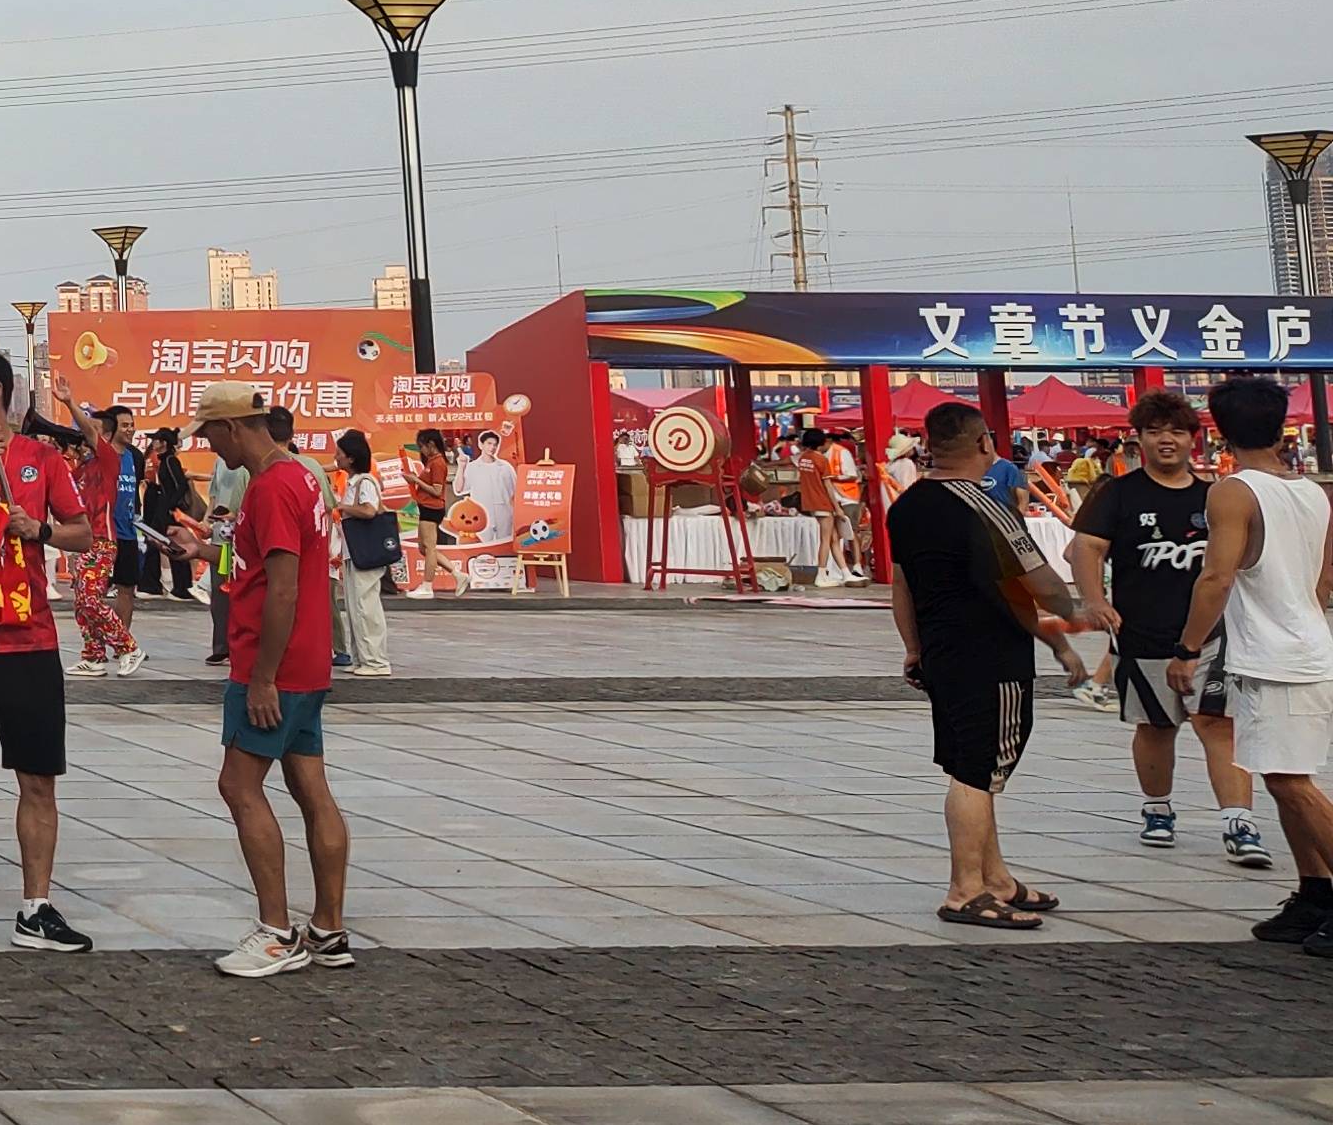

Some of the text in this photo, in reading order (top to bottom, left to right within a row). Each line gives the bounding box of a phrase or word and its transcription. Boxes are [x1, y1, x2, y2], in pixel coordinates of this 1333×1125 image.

[918, 302, 1312, 361] 文章节义金庐
[148, 338, 311, 375] 淘宝闪购
[391, 375, 471, 393] 淘宝闪购
[1139, 513, 1157, 527] 93
